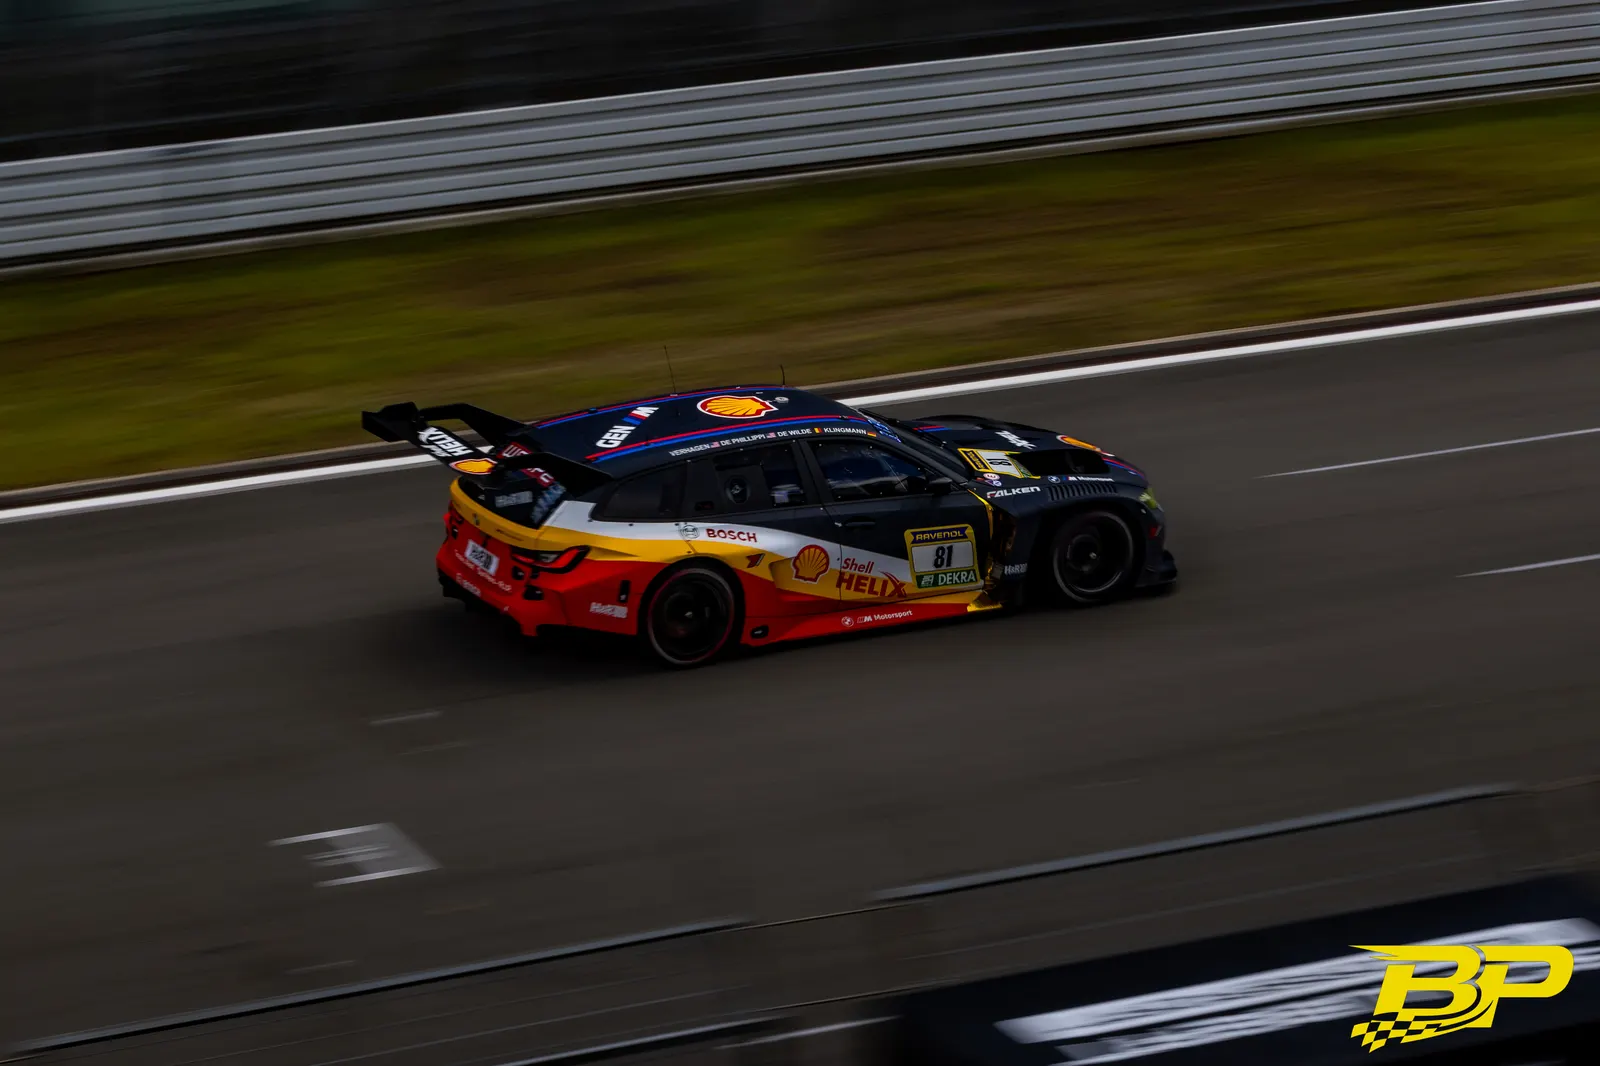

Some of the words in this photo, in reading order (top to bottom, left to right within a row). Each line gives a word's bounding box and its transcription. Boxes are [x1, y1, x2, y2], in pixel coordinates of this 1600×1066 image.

[596, 425, 637, 448] GEN
[788, 428, 813, 436] WILDE
[823, 427, 867, 435] KLINGMANN
[720, 439, 731, 447] DE
[987, 486, 1041, 499] FALKEN
[706, 528, 757, 543] BOSCH
[915, 528, 965, 541] RAVENOL
[933, 545, 954, 569] 81
[842, 558, 875, 574] Shell
[836, 571, 907, 598] HELIX
[938, 570, 976, 587] DEKRA
[874, 610, 914, 622] Motorsport
